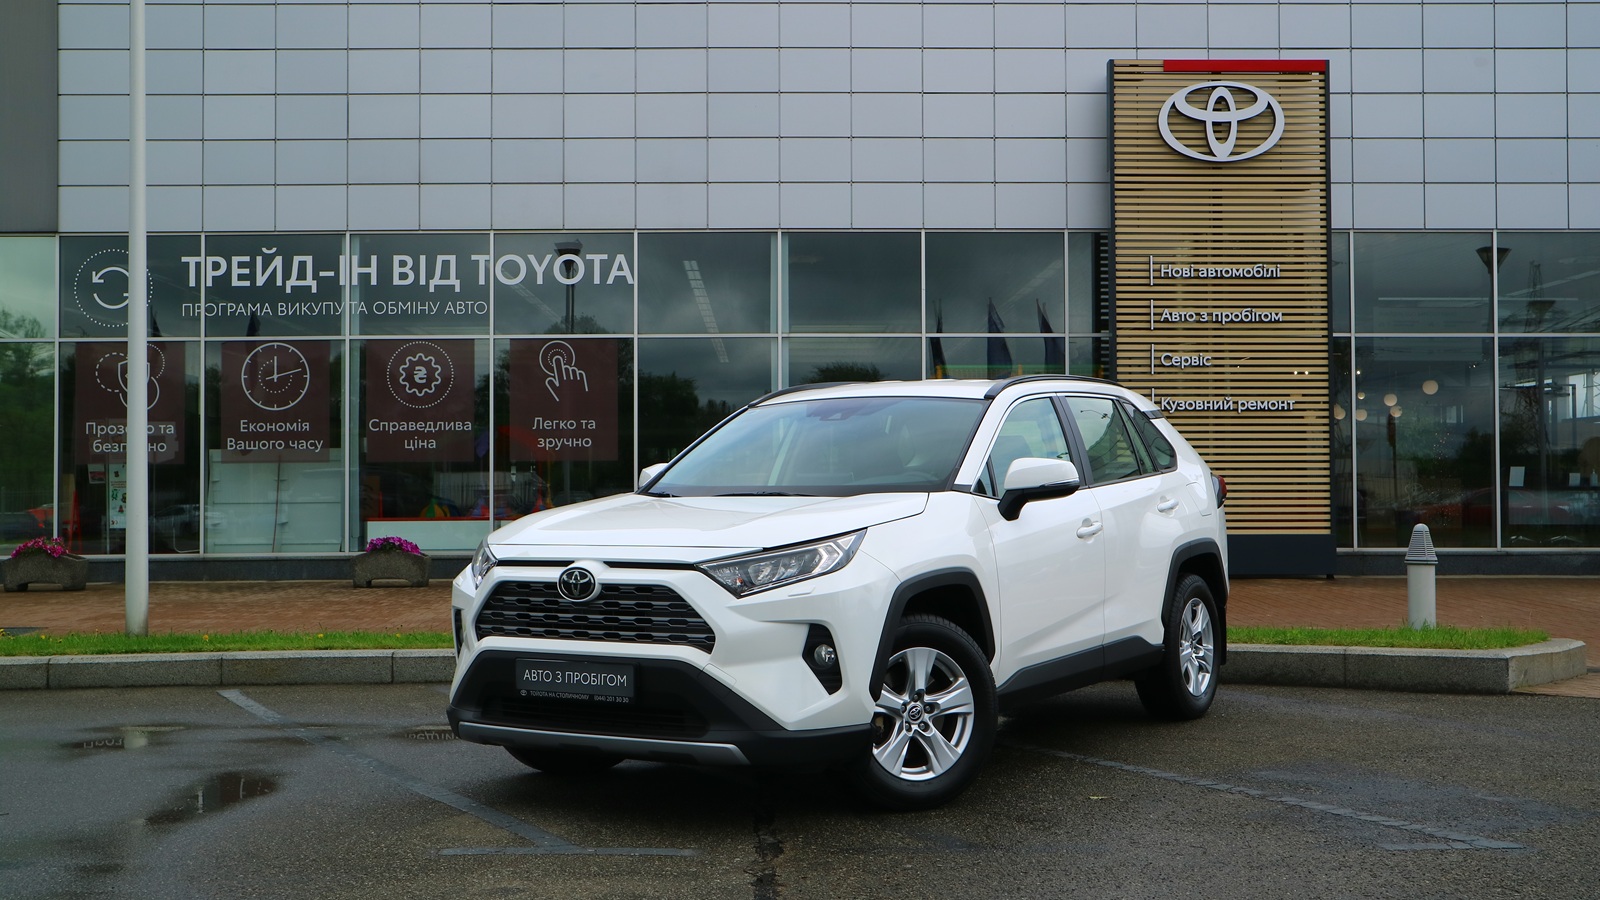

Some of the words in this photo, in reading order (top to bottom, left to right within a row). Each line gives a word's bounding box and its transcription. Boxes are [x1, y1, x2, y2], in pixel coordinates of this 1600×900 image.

[181, 247, 378, 294] ТРЕЙД-ІН
[392, 254, 461, 293] ВІД
[1160, 264, 1195, 278] Нові
[1198, 263, 1281, 278] автомобілі
[182, 302, 272, 317] ПРОГРАМА
[277, 302, 345, 316] ВИКУПУ
[350, 301, 368, 315] ТА
[373, 301, 440, 315] ОБМІНУ
[444, 301, 488, 315] АВТО
[1160, 308, 1196, 322] Авто
[1199, 310, 1208, 322] з
[1212, 307, 1283, 325] пробігом
[1160, 352, 1212, 369] Сервіс
[1160, 396, 1234, 413] Кузовний
[1237, 400, 1296, 413] ремонт
[85, 422, 155, 438] Прозо
[158, 424, 175, 434] та
[239, 418, 310, 432] Економія
[368, 418, 473, 434] Справедлива
[532, 416, 577, 430] Легко
[580, 419, 596, 430] та
[92, 439, 167, 452] безпно
[226, 437, 286, 450] Вашого
[289, 441, 324, 453] часу
[404, 436, 437, 450] ціна
[537, 437, 592, 451] зручно
[523, 669, 553, 683] АВТО
[565, 671, 627, 687] ПРОБІГОМ
